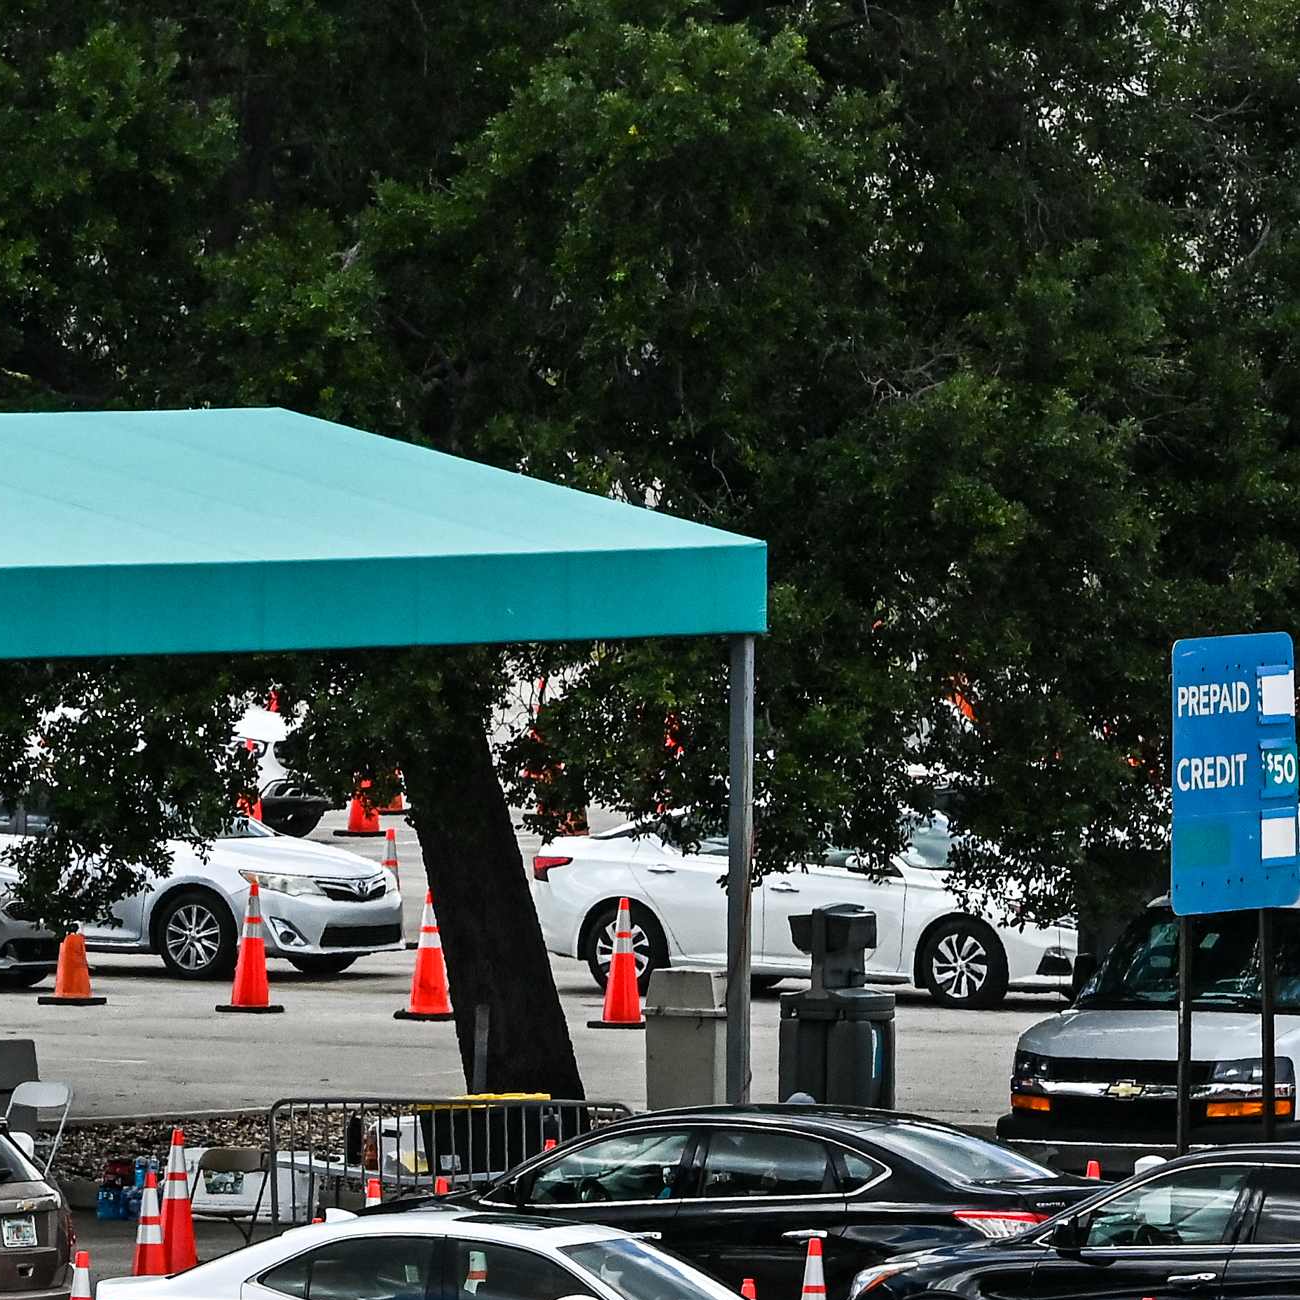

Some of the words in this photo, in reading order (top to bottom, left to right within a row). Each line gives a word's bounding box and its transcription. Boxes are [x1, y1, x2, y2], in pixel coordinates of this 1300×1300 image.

[1177, 681, 1250, 717] PREPAID
[1177, 753, 1248, 791] CREDIT
[1266, 753, 1296, 784] $50
